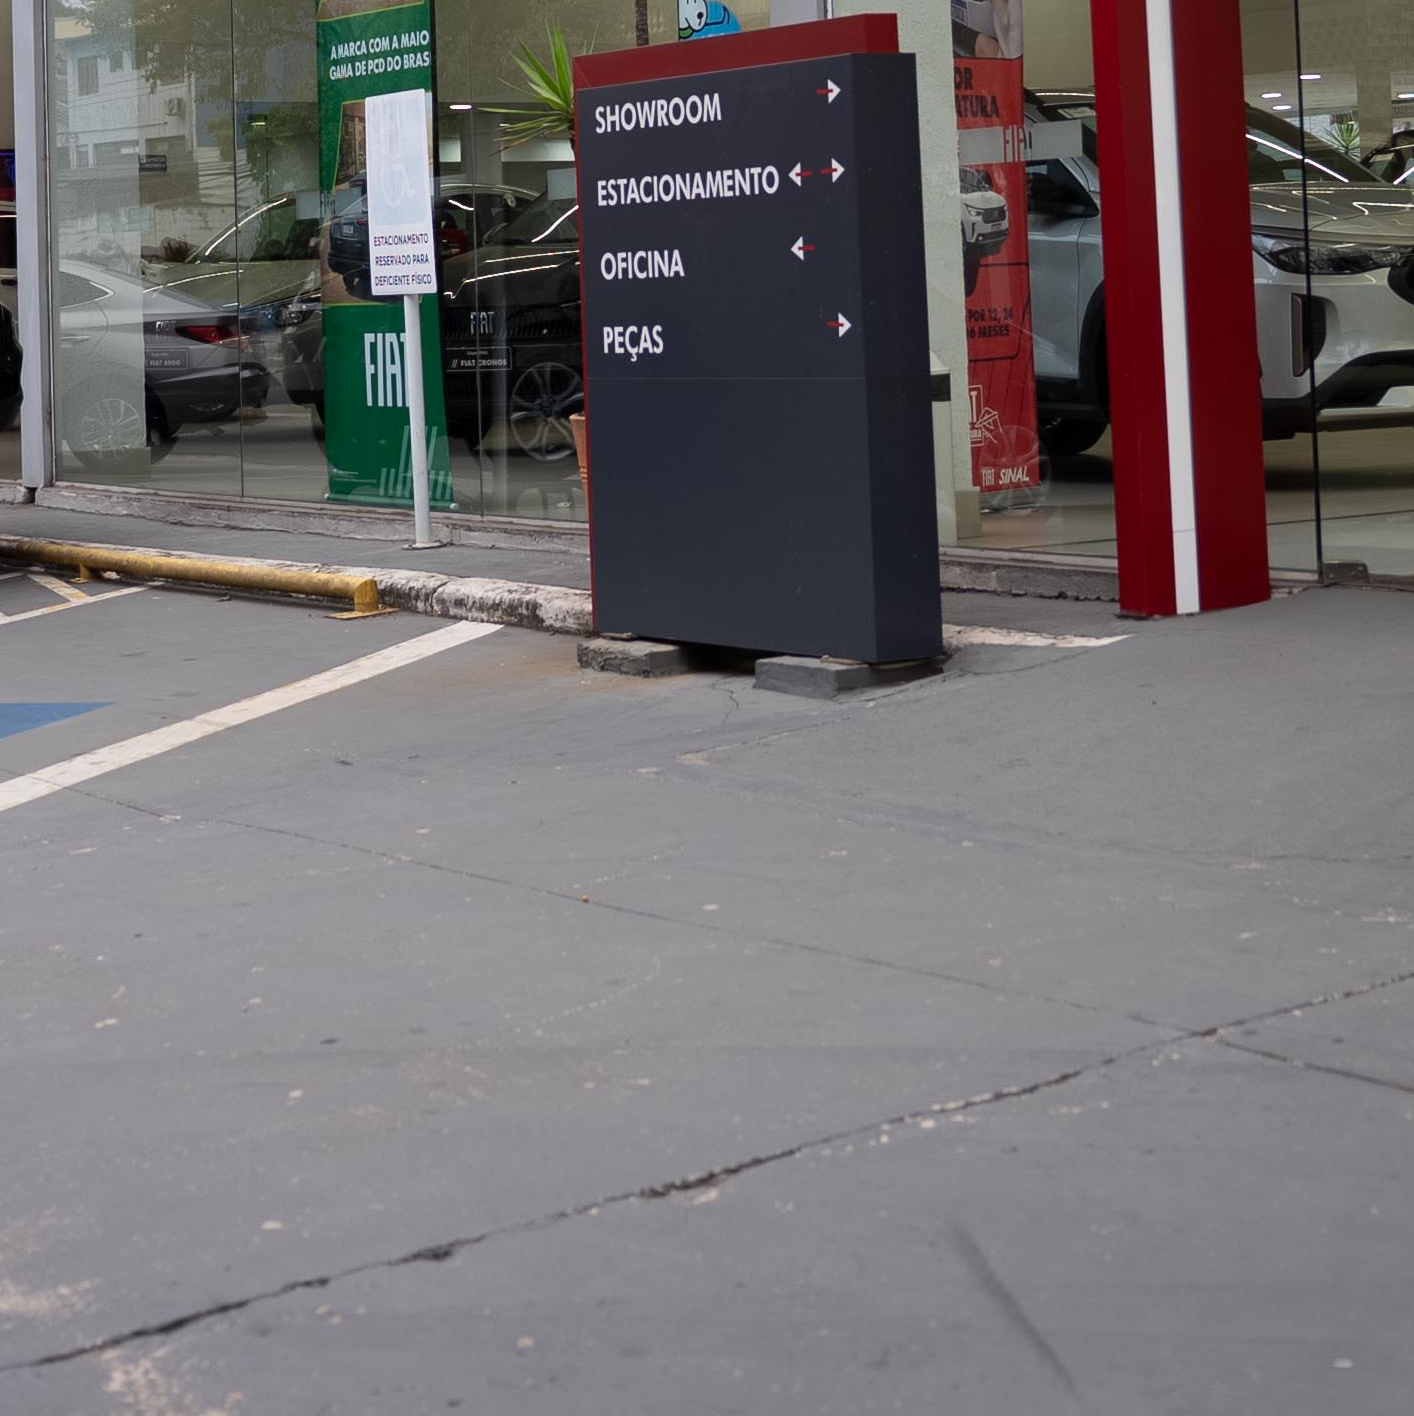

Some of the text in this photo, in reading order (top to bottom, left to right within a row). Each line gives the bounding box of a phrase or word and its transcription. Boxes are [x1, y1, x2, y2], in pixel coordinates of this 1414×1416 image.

[330, 45, 337, 60] A
[338, 40, 367, 58] MARCA
[368, 35, 390, 53] COM
[391, 35, 399, 50] A
[329, 63, 353, 80] GAMA
[355, 61, 366, 76] DE
[367, 58, 385, 74] PCD
[386, 55, 401, 71] DO
[595, 93, 722, 134] SHOWROOM
[597, 165, 779, 207] ESTACIONAMENTO
[373, 233, 429, 247] ESTACIONAMENTO
[375, 253, 429, 266] RESERVADO PARA
[600, 249, 685, 280] OFICINA
[375, 272, 432, 287] DEFICIENTE FÍSICO
[603, 325, 664, 361] PEÇAS
[478, 358, 507, 366] CRONOS
[999, 465, 1030, 484] SINAL
